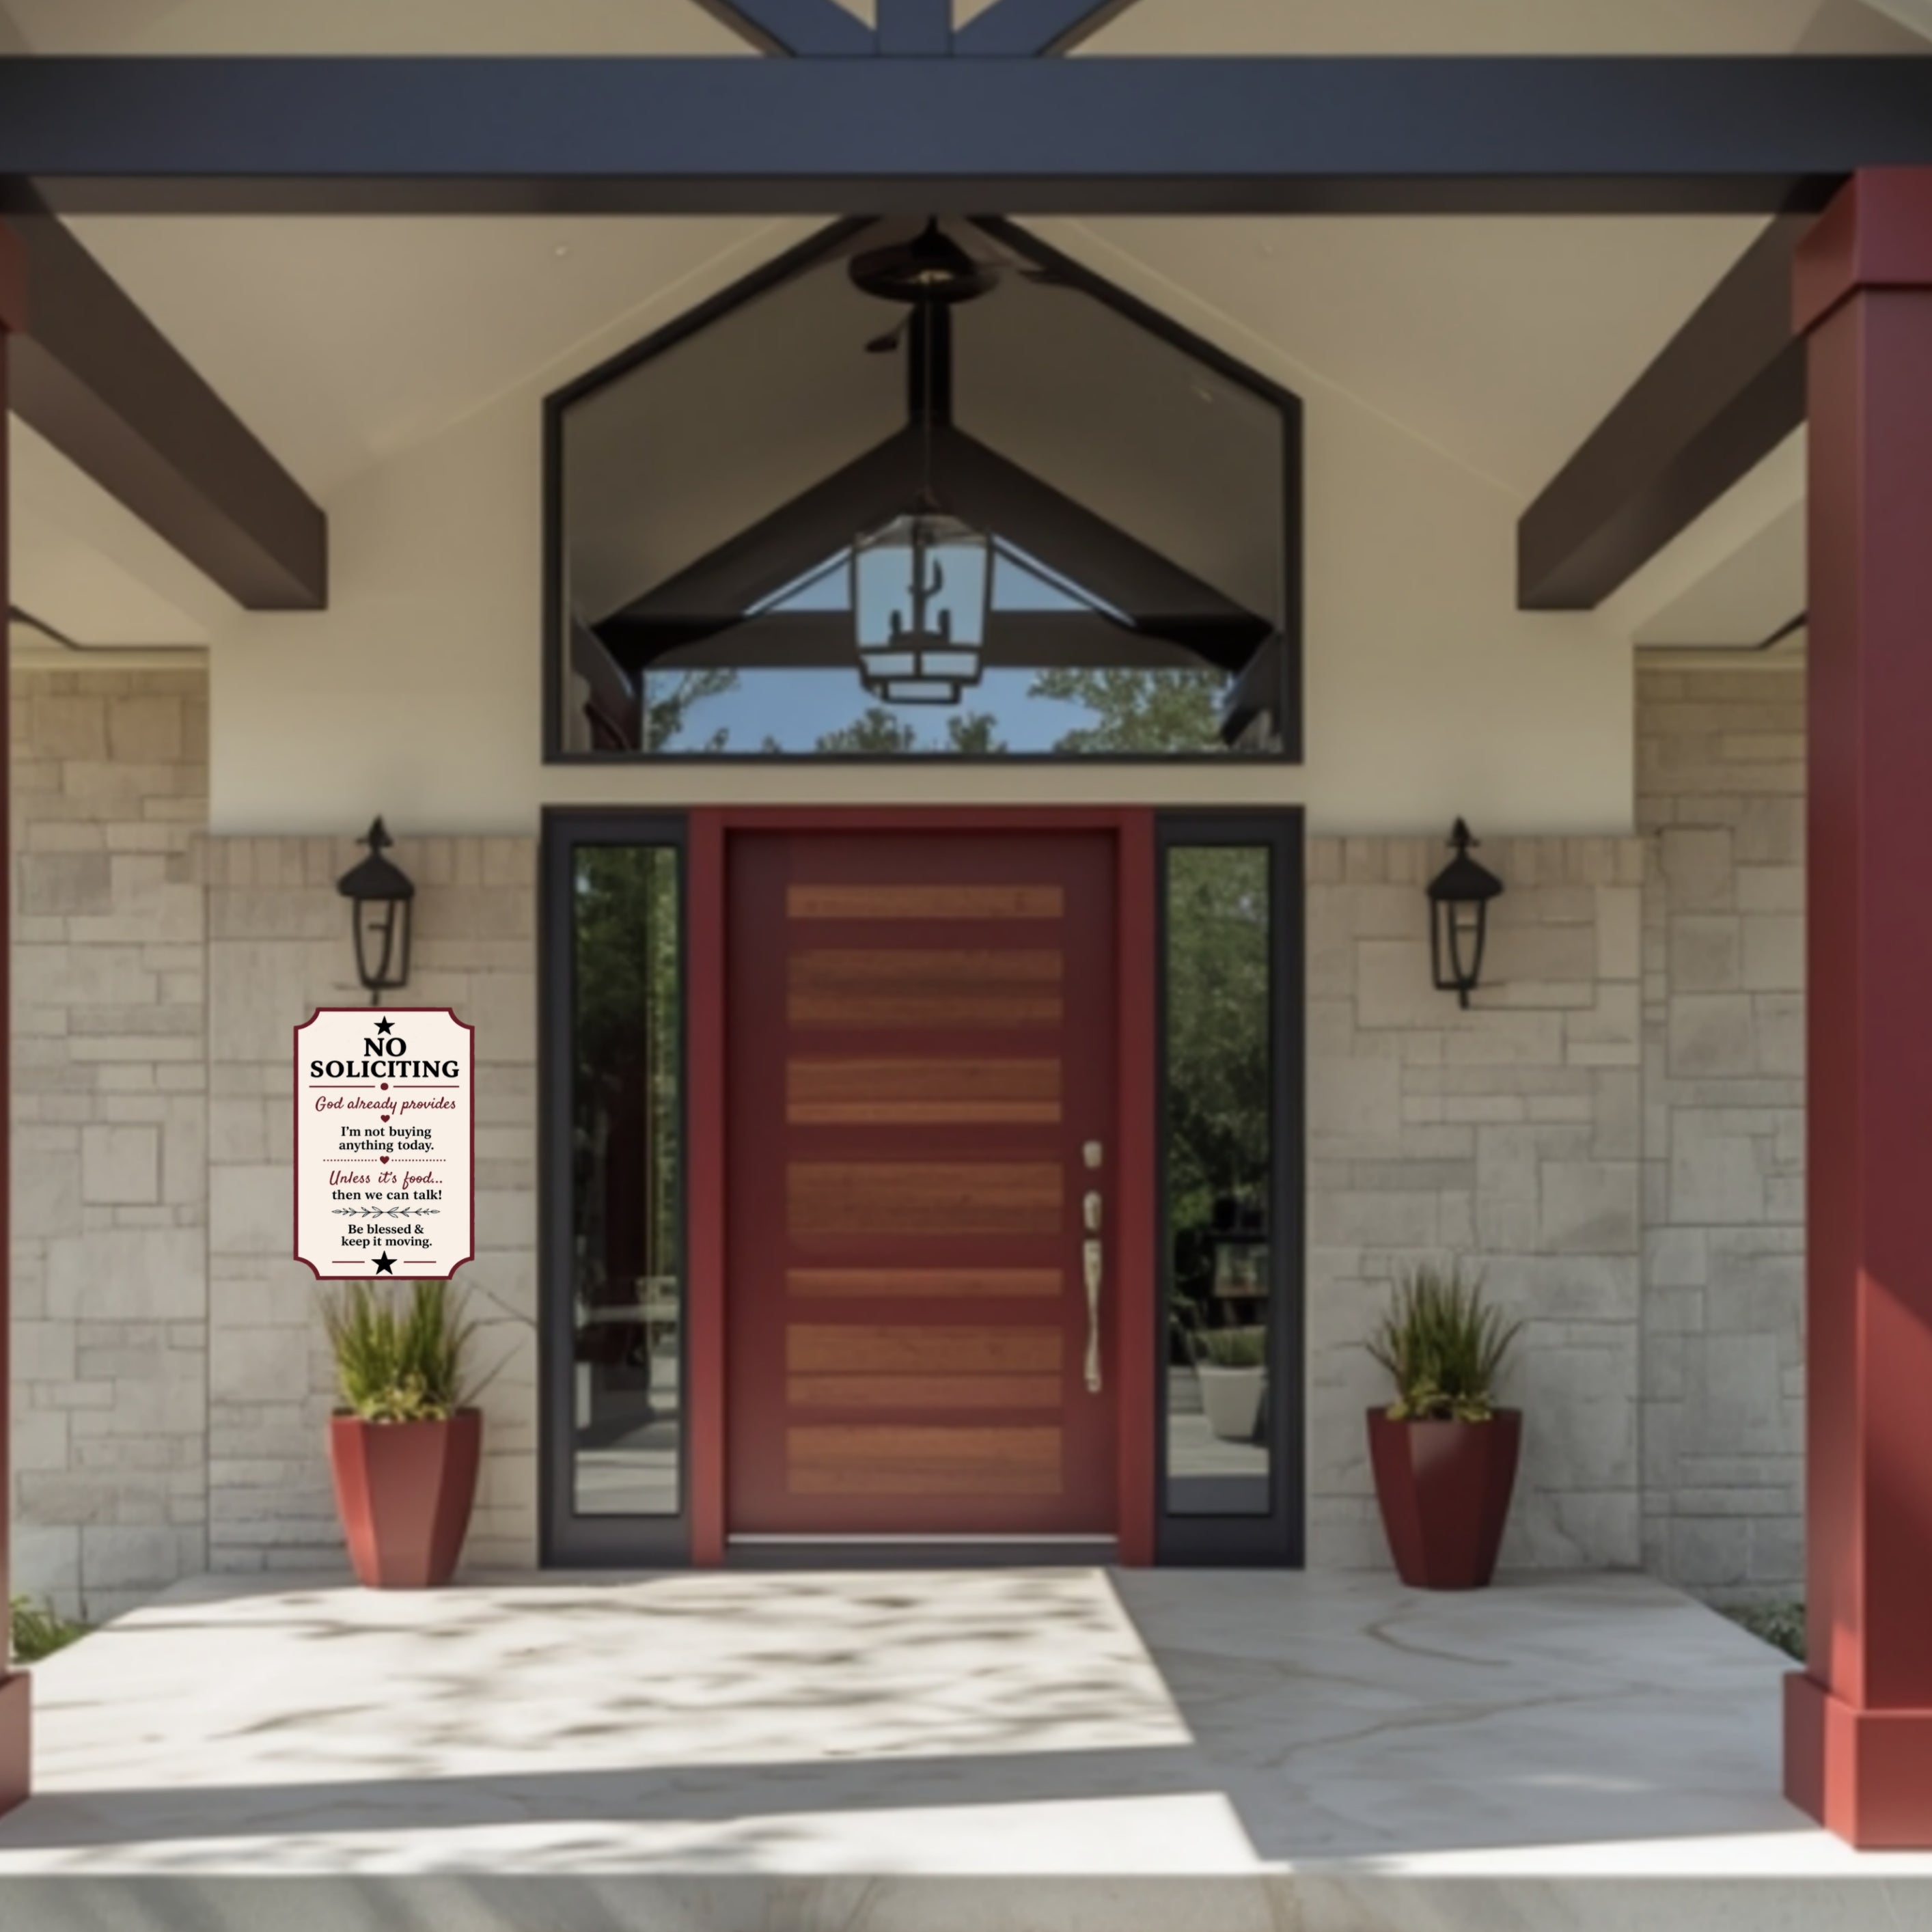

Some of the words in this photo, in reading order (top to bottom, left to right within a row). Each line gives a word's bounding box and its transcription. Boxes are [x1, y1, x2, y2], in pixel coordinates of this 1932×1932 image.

[364, 1038, 406, 1057] NO
[311, 1060, 459, 1078] SOLICITING
[316, 1096, 344, 1112] God
[348, 1097, 397, 1114] already
[400, 1096, 456, 1115] provides
[365, 1128, 385, 1136] not
[389, 1126, 431, 1139] buying
[339, 1140, 394, 1153] anything
[398, 1140, 434, 1153] today.
[330, 1170, 370, 1185] Unless
[402, 1171, 442, 1189] food...
[332, 1189, 361, 1200] then
[413, 1189, 441, 1200] talk!
[348, 1224, 363, 1234] Be
[367, 1224, 411, 1234] blessed
[415, 1224, 424, 1234] &
[342, 1236, 370, 1248] keep
[373, 1237, 381, 1246] it
[385, 1237, 432, 1248] moving.
